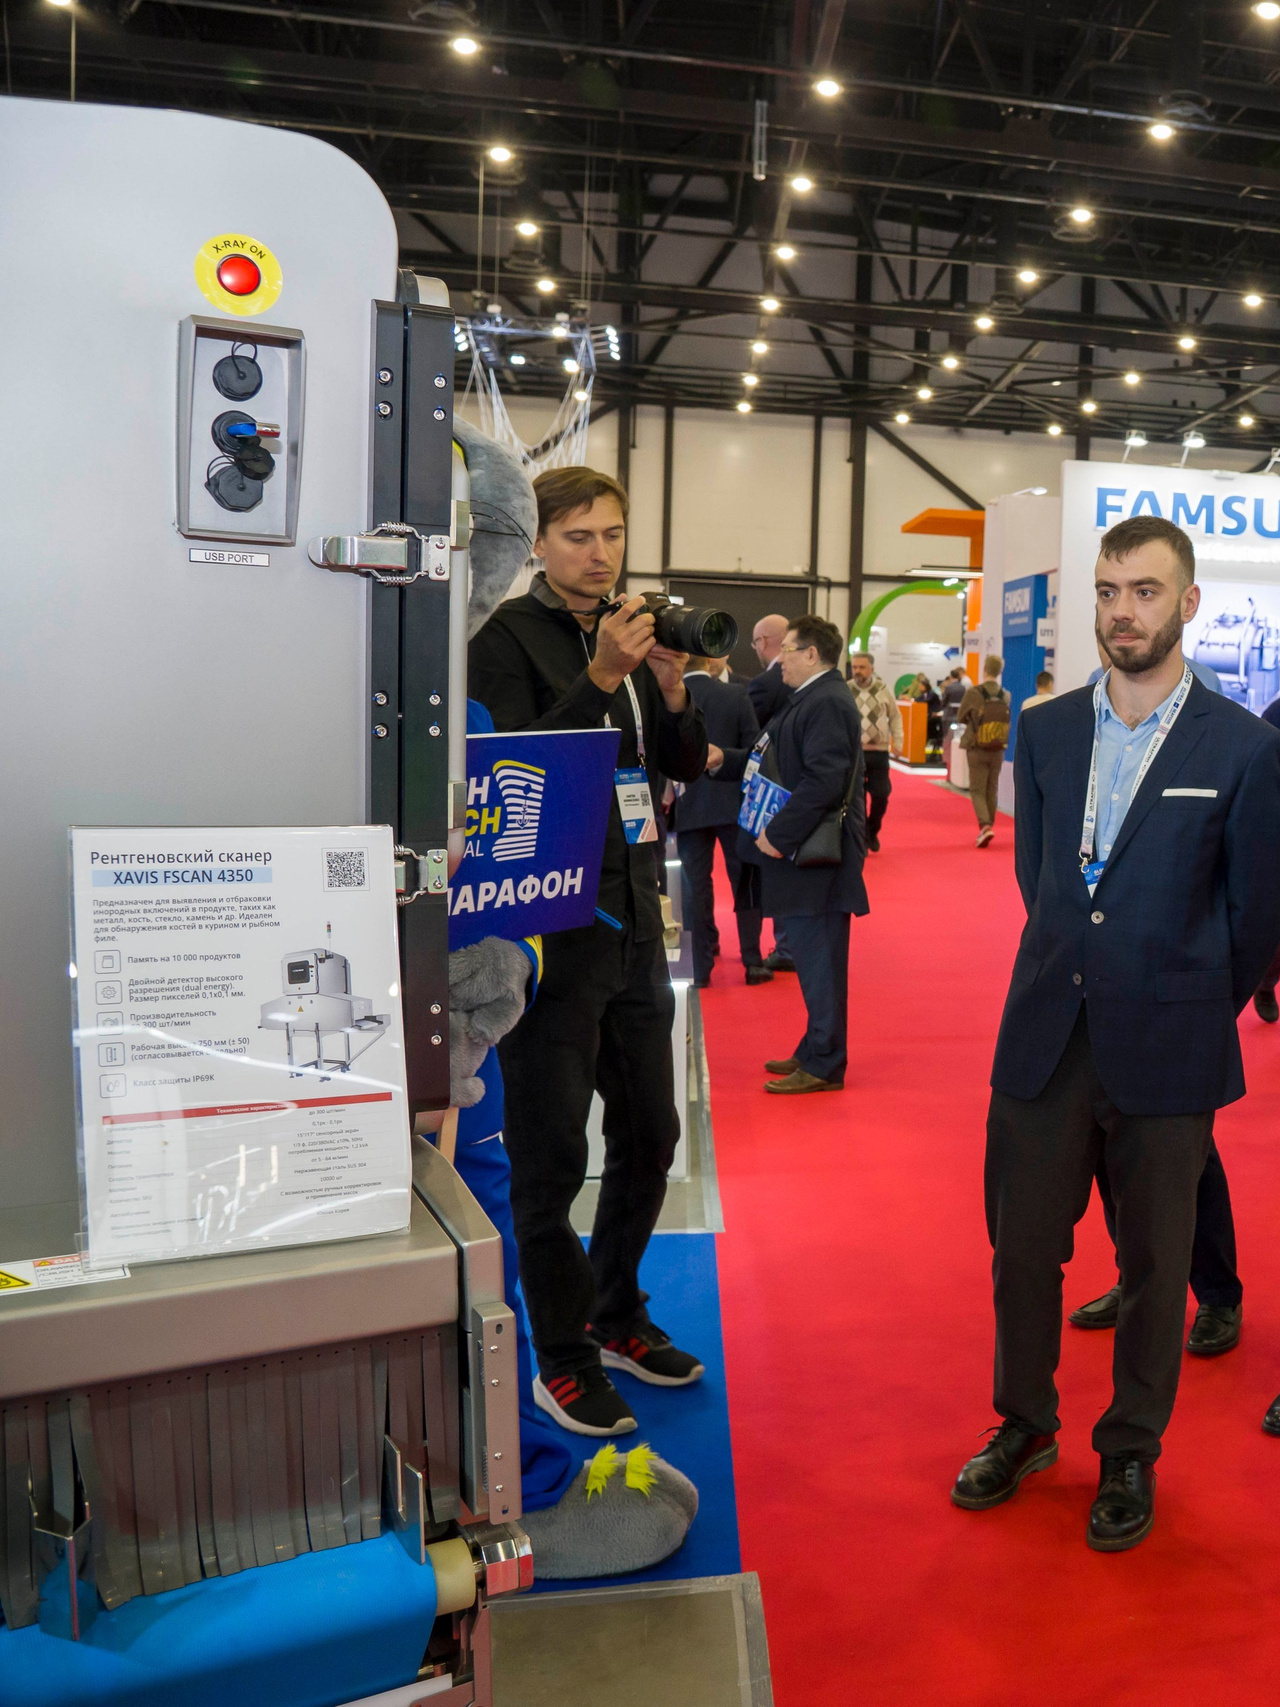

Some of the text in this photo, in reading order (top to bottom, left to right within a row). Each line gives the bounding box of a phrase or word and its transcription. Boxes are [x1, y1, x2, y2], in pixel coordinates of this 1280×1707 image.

[212, 240, 266, 259] X-RAY ON
[204, 552, 254, 563] USB PORT
[467, 776, 490, 806] H
[90, 850, 272, 865] Рентгеновский сканер
[113, 868, 254, 884] XAVIS FSCAN 4350
[93, 899, 154, 908] Предназначен
[155, 899, 170, 907] для
[172, 897, 216, 906] выявления
[226, 895, 272, 904] отбраковки
[93, 907, 140, 917] инородных
[143, 905, 190, 914] включений
[198, 904, 238, 914] продукте,
[94, 916, 126, 926] металл,
[128, 915, 153, 924] кость,
[155, 914, 184, 923] стекло,
[186, 914, 216, 922] камень
[225, 914, 238, 922] др.
[240, 912, 272, 921] Идеален
[94, 926, 109, 934] для
[111, 922, 168, 933] обнаружения
[170, 920, 196, 930] костей
[205, 922, 240, 932] курином
[248, 918, 281, 930] рыбном
[94, 933, 118, 943] филе.
[200, 952, 241, 962] продуктов
[128, 974, 244, 988] Двойной детектор высокого
[129, 982, 234, 995] разрешения (dual energy).
[130, 994, 160, 1003] Размер
[162, 991, 200, 1001] пикселей
[130, 1010, 217, 1022] Производительность
[159, 1020, 191, 1028] шт/мин
[131, 1044, 165, 1052] Рабочая
[238, 1037, 250, 1046] 50)
[131, 1050, 204, 1062] (согласовывается
[160, 1077, 191, 1086] защиты
[193, 1074, 215, 1082] IP69K
